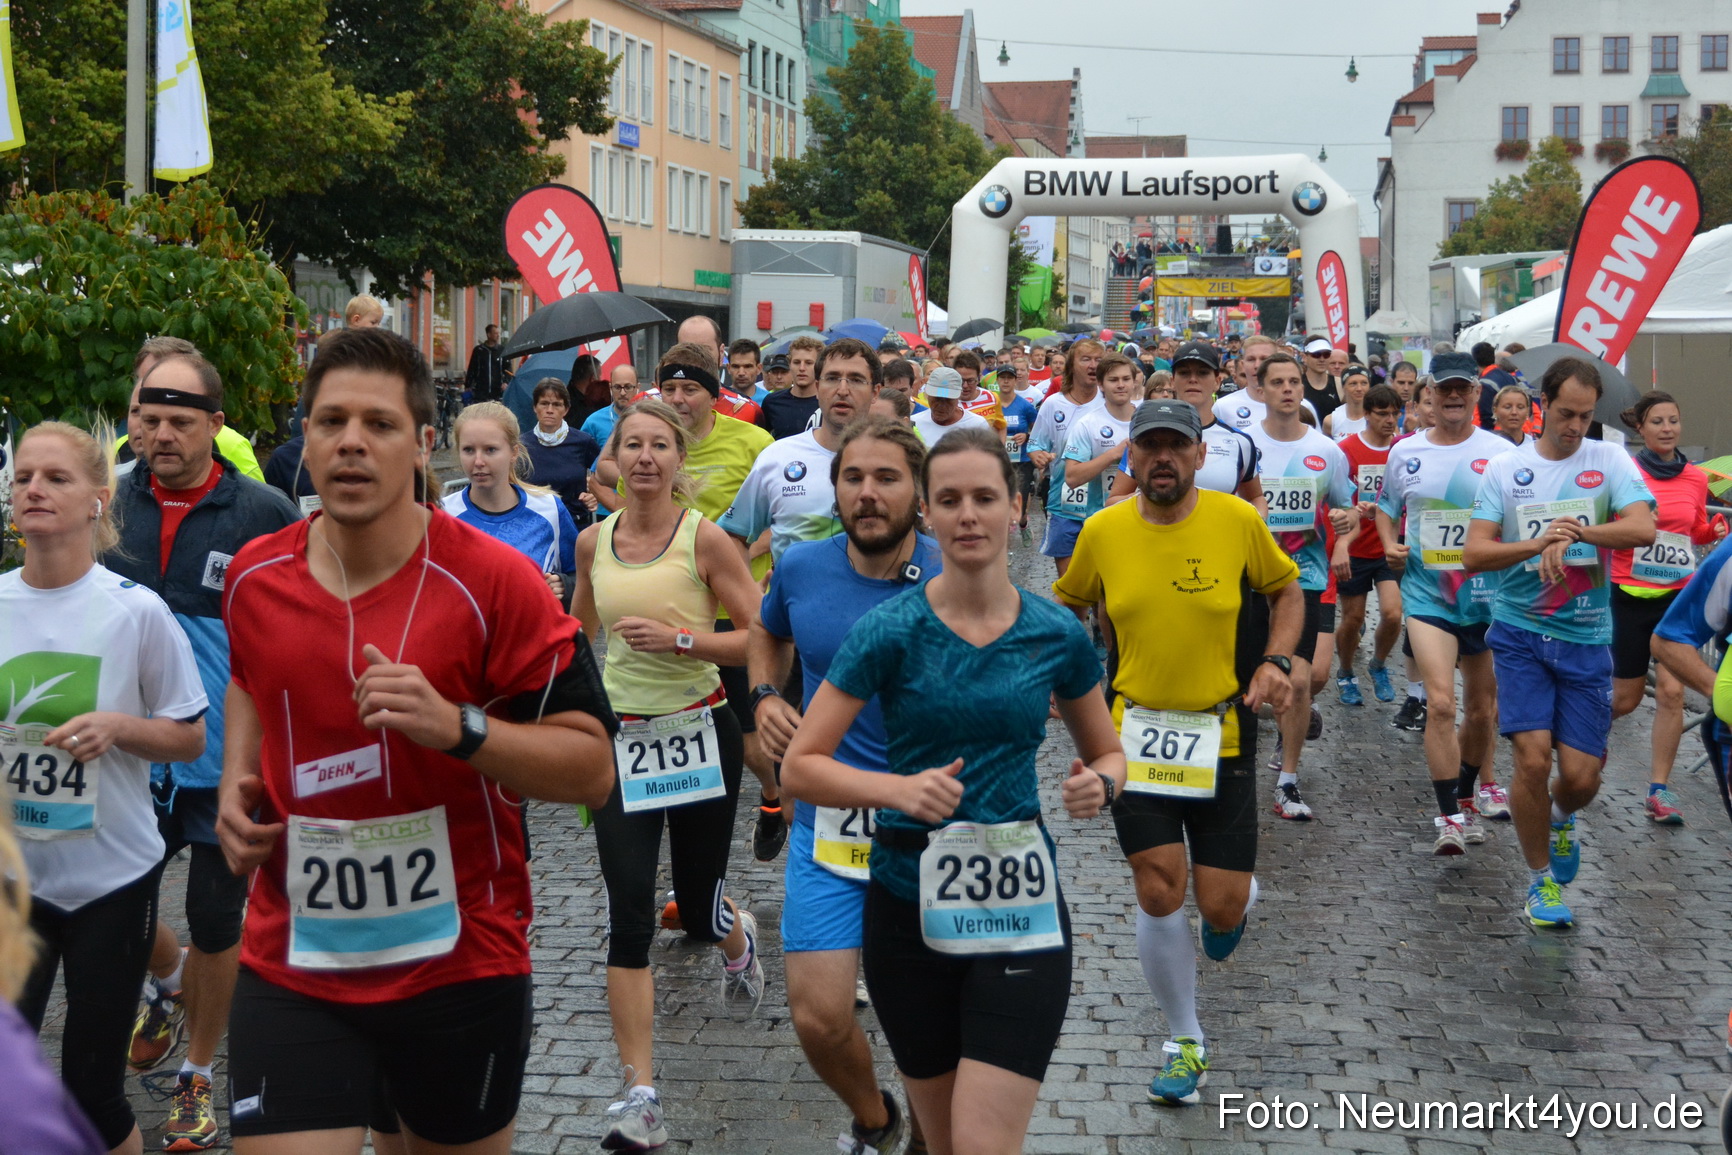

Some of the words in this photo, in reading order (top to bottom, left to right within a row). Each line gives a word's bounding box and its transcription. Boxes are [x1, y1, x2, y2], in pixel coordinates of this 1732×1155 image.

[1024, 170, 1112, 196] BMW
[1122, 170, 1279, 201] Laufsport
[1567, 184, 1681, 360] REWE
[1208, 282, 1239, 293] ZIEL
[782, 485, 806, 493] PARTL
[1263, 490, 1312, 511] 2488
[1269, 515, 1304, 525] Christian
[1438, 524, 1465, 547] 72
[1640, 543, 1690, 566] 2023
[1644, 566, 1681, 579] Elisabeth
[1176, 585, 1214, 595] Burgthann
[1575, 595, 1591, 608] 17.
[1131, 713, 1161, 722] NeuerMarkt
[1167, 711, 1213, 727] BOCK
[627, 730, 707, 775] 2131
[1139, 727, 1202, 761] 267
[0, 752, 87, 797] 434
[317, 760, 355, 783] DEHN
[1147, 767, 1184, 783] Bernd
[645, 775, 701, 796] Manuela
[298, 834, 344, 846] NeuerMarkt
[352, 816, 432, 843] BOCK
[303, 847, 440, 911] 2012
[936, 850, 1046, 902] 2389
[296, 904, 303, 915] A
[926, 898, 933, 908] D
[953, 913, 1030, 934] Veronika
